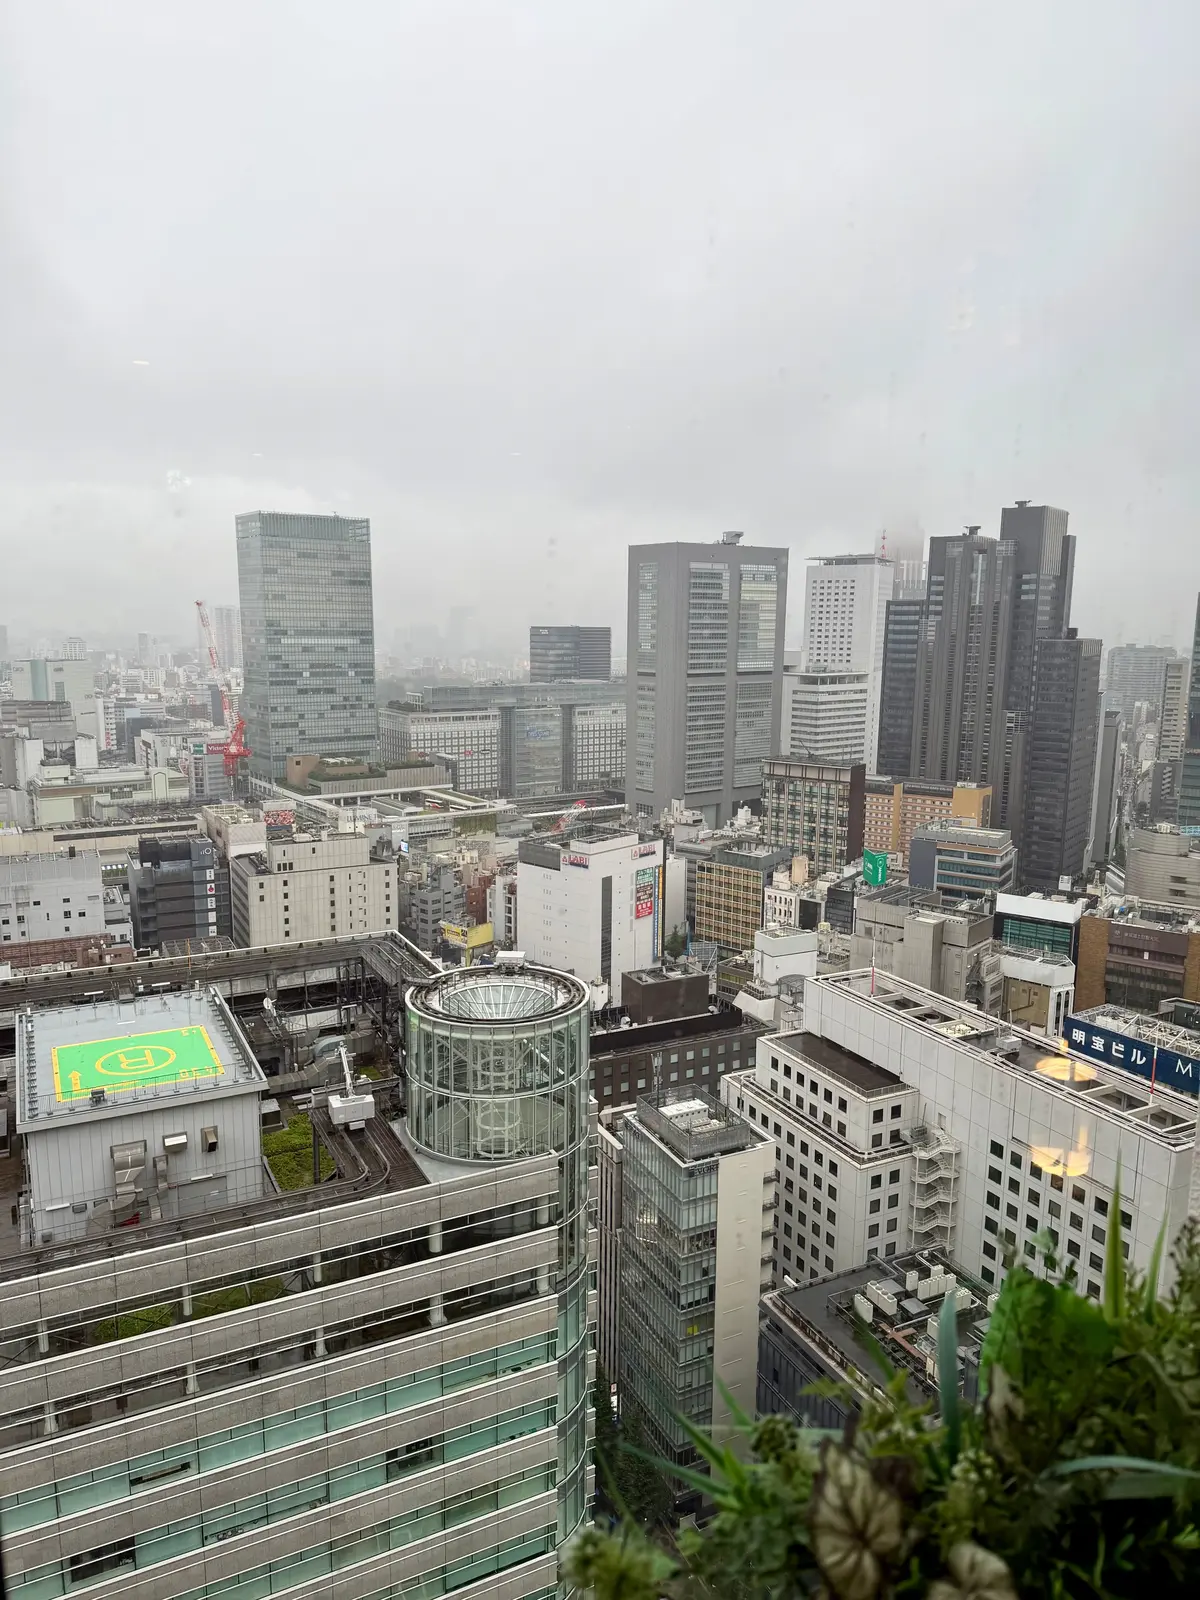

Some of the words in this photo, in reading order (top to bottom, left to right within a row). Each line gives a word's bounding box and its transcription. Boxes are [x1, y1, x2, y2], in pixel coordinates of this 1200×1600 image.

[568, 854, 588, 865] LABI
[1072, 1028, 1147, 1065] 明宝ビル
[119, 1050, 154, 1069] R
